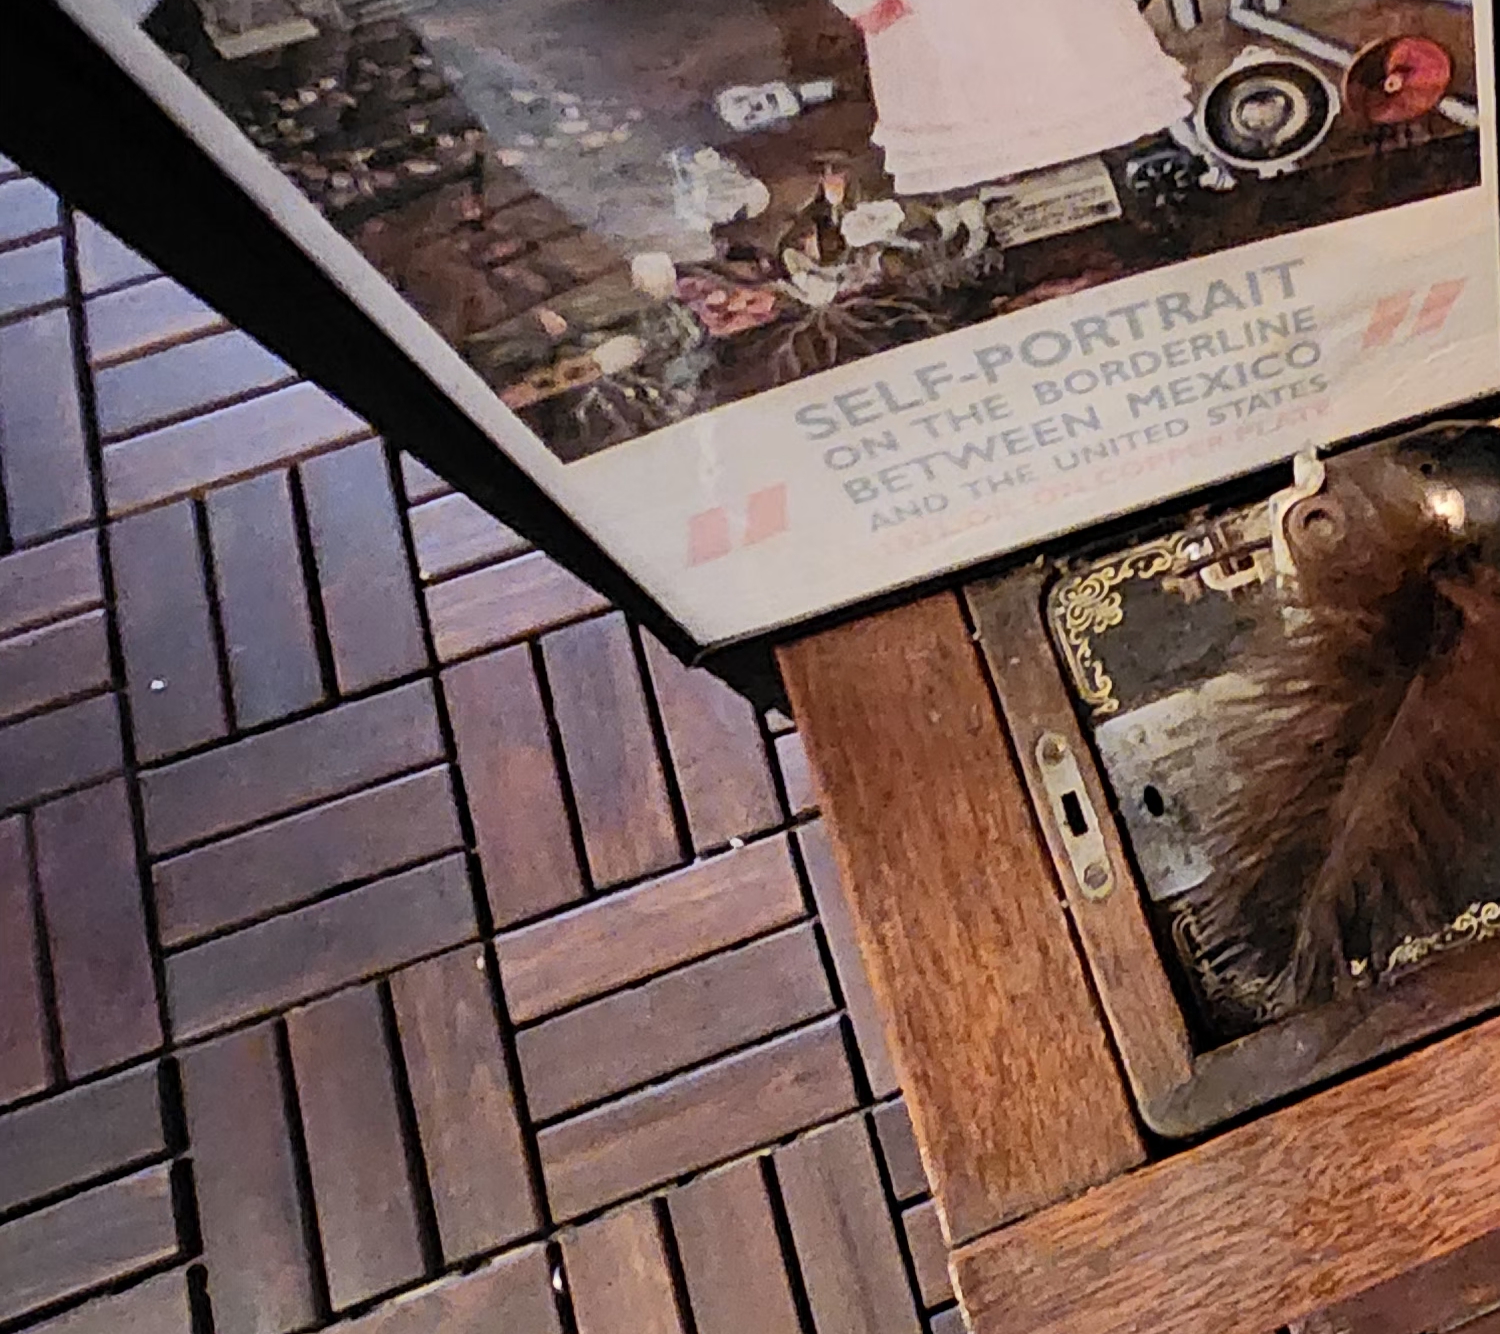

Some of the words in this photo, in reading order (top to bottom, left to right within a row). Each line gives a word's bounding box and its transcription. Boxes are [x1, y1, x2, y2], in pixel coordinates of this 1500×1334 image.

[795, 257, 1306, 441] SELF-PORTRAIT
[823, 429, 900, 471] ON
[910, 398, 1015, 441] THE
[1032, 304, 1318, 406] BORDERLINE
[842, 405, 1101, 505] BETWEEN
[1126, 339, 1322, 419] MEXICO
[870, 493, 950, 533] AND
[966, 464, 1041, 502] THE
[1053, 418, 1189, 471] UNITED
[1207, 373, 1329, 427] STATES
